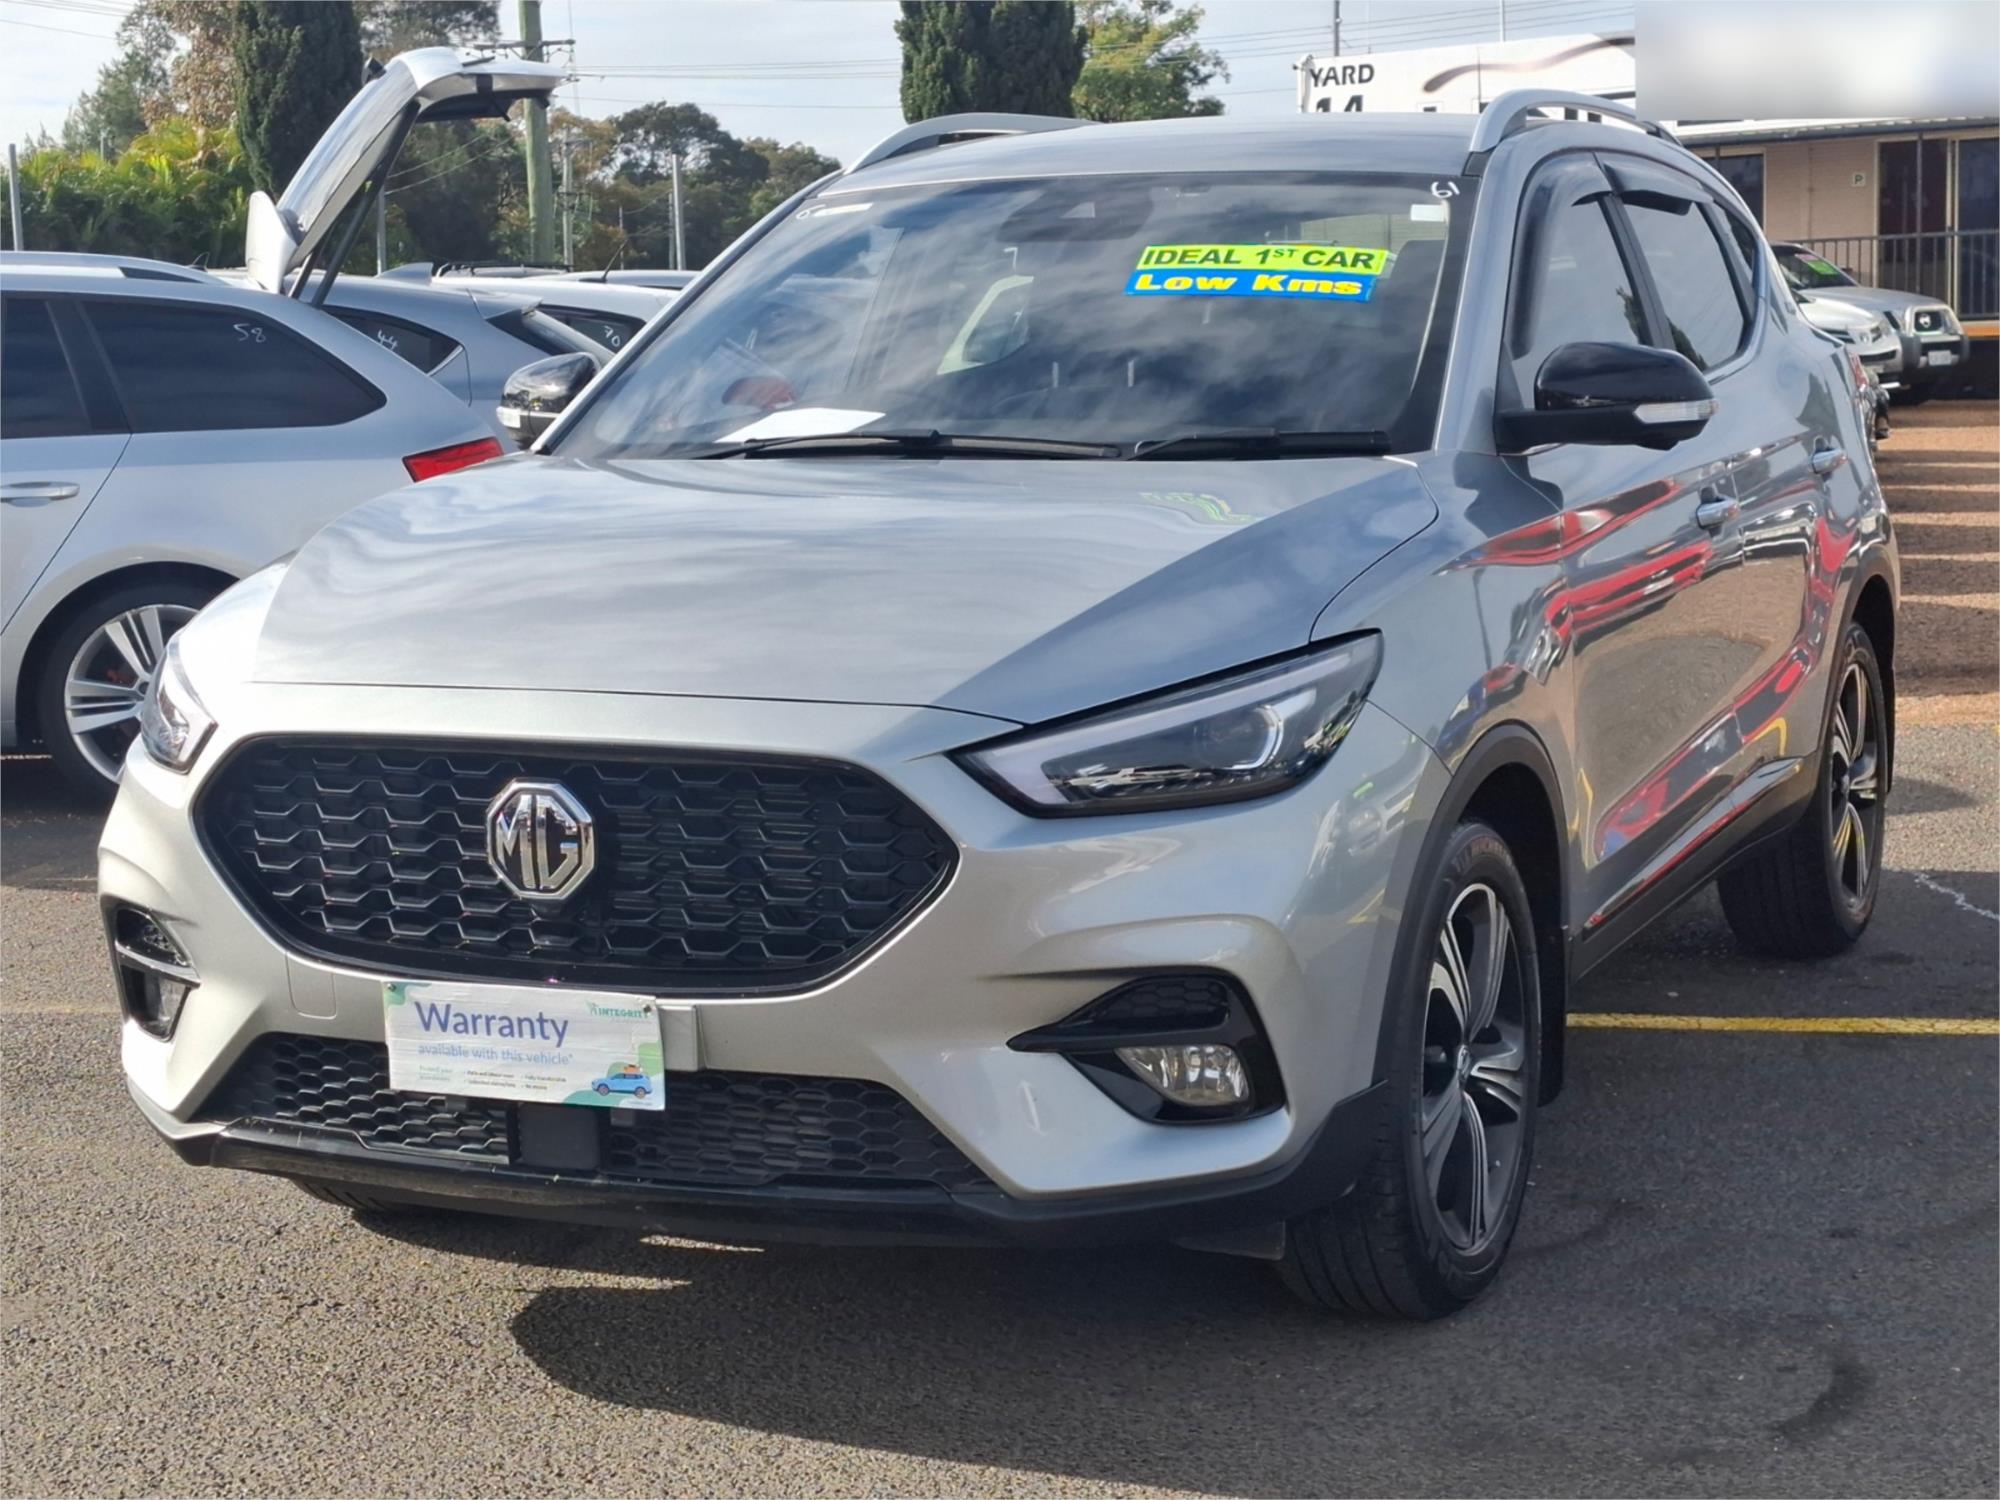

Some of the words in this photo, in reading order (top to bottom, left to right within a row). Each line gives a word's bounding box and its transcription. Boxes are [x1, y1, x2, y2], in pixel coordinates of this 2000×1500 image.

[1309, 63, 1375, 88] YARD
[1142, 248, 1242, 266] IDEAL
[1301, 250, 1376, 270] CAR
[1134, 273, 1239, 292] Low
[1251, 273, 1363, 296] Kms
[232, 322, 267, 344] 58
[495, 793, 579, 891] MG
[414, 1000, 569, 1049] Warranty
[417, 1043, 470, 1058] available
[472, 1046, 499, 1061] with
[501, 1048, 524, 1063] this
